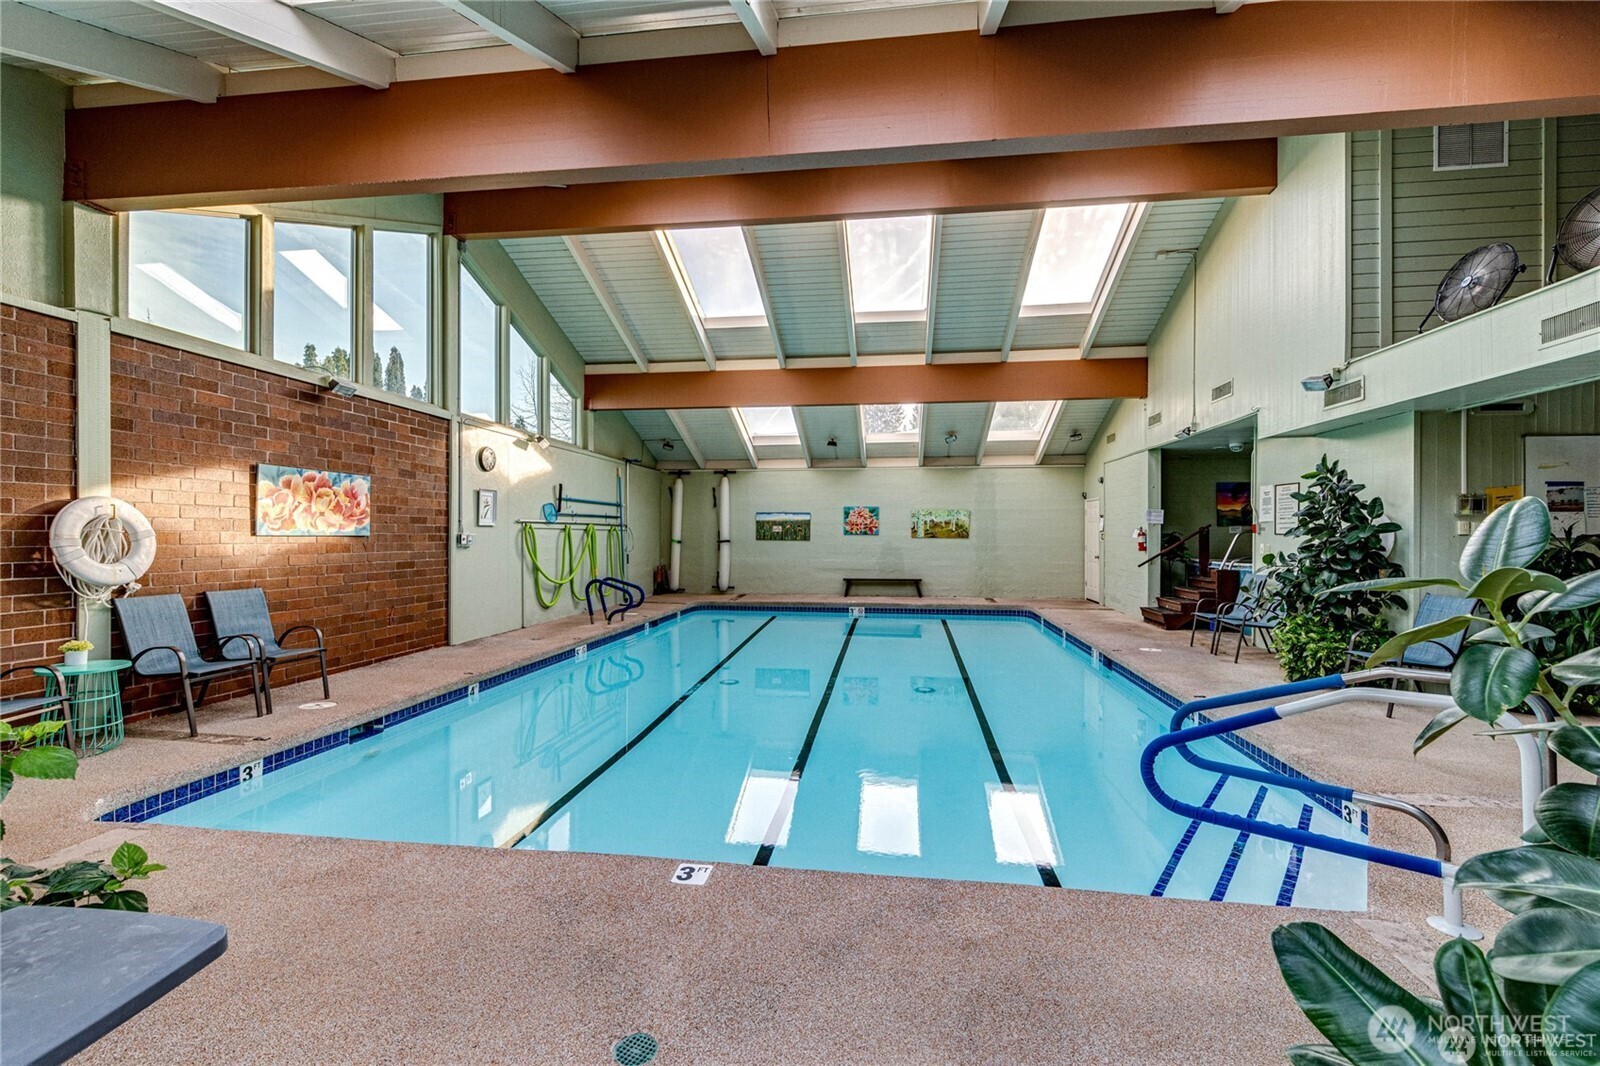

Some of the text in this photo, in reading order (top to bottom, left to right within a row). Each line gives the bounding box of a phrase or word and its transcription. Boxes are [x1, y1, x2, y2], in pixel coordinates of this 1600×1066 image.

[242, 766, 253, 782] 3
[1344, 805, 1352, 824] 3
[676, 866, 696, 881] 3
